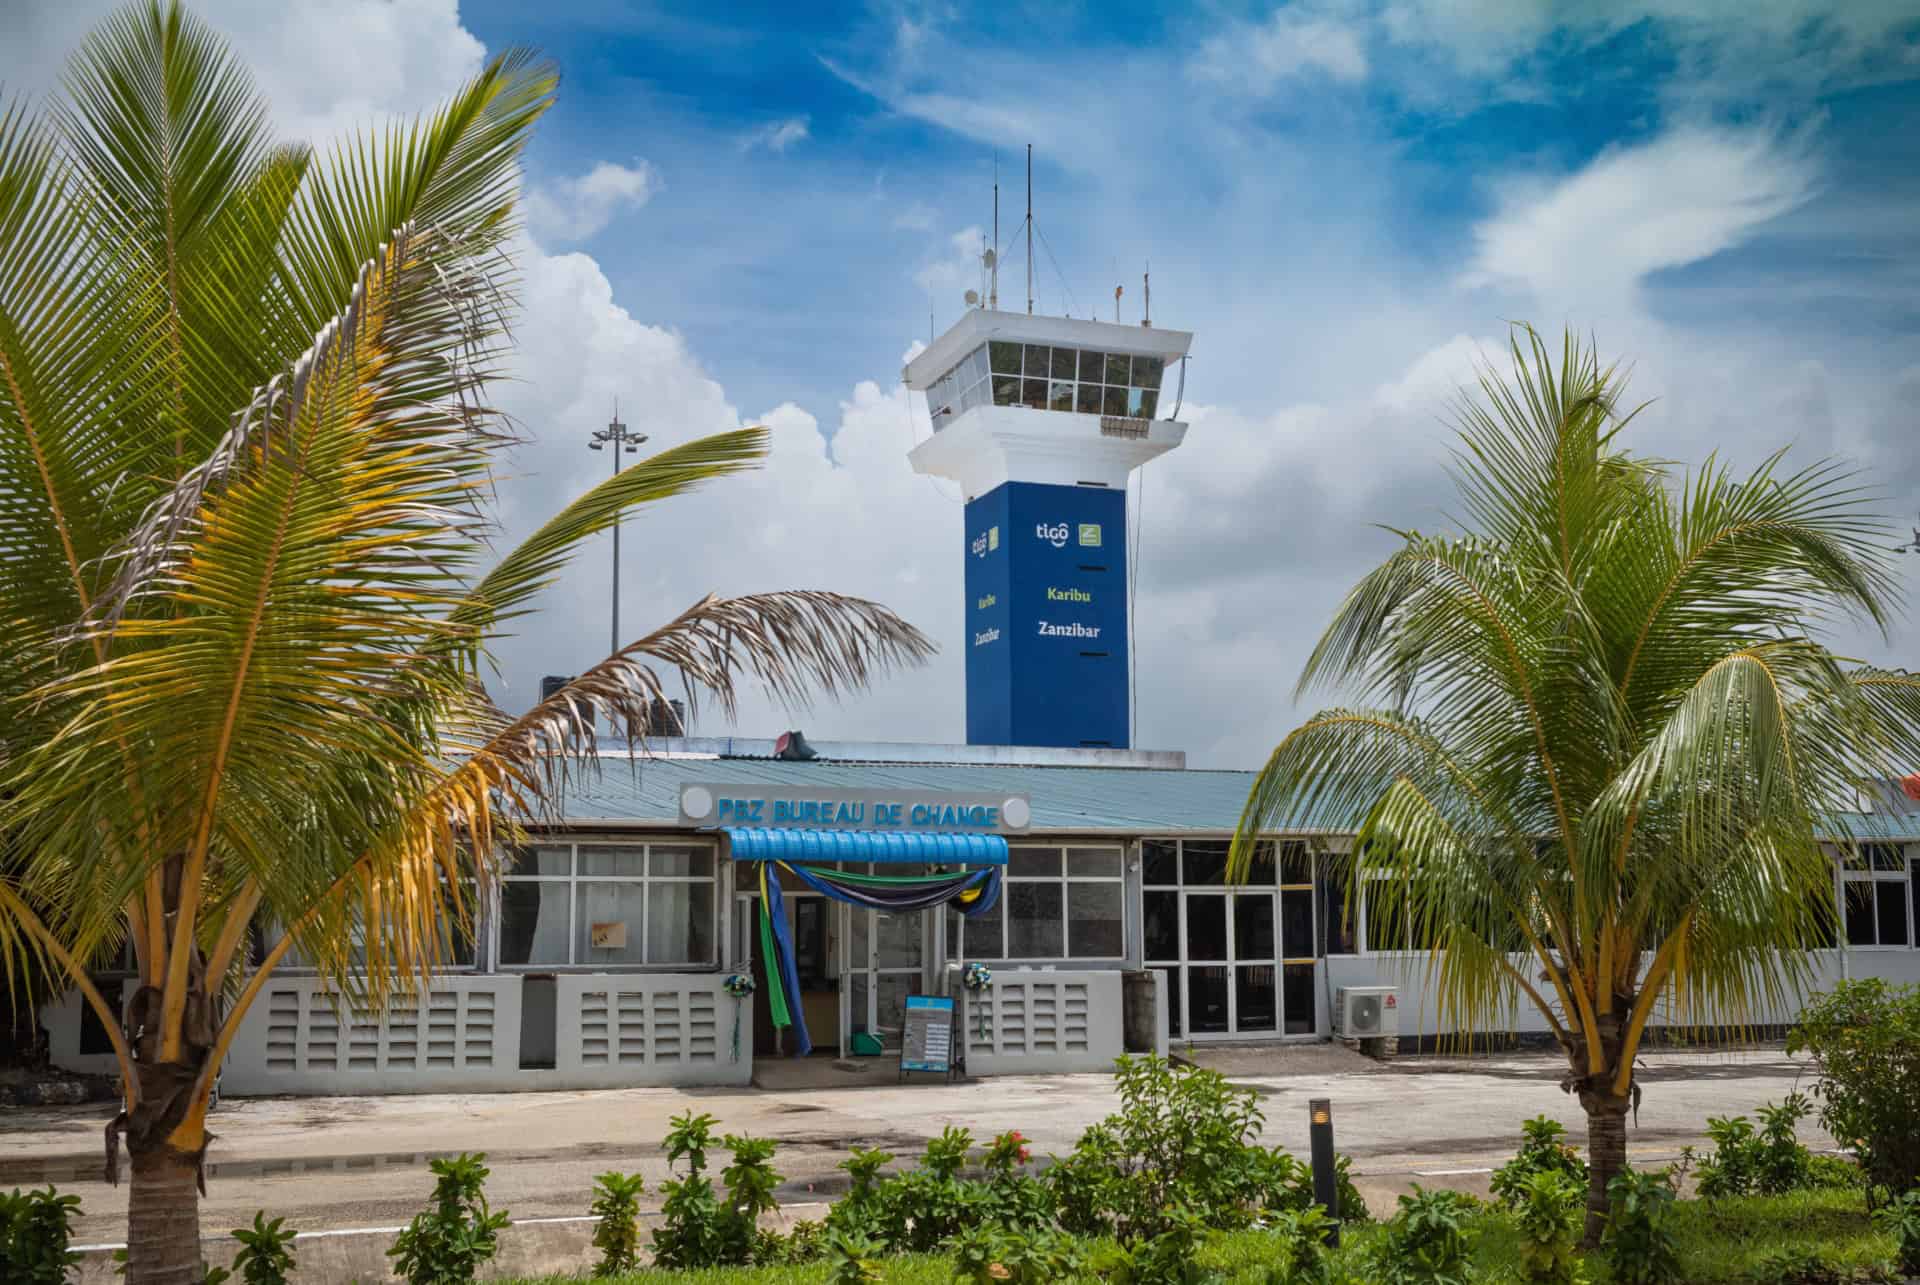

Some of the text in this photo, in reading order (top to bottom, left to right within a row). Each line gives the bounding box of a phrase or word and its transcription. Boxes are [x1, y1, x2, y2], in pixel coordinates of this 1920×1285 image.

[1047, 587, 1091, 601] Karibu
[1039, 621, 1100, 638] Zanzibar
[719, 799, 1000, 828] PBZ BUREAU DE CHANGE
